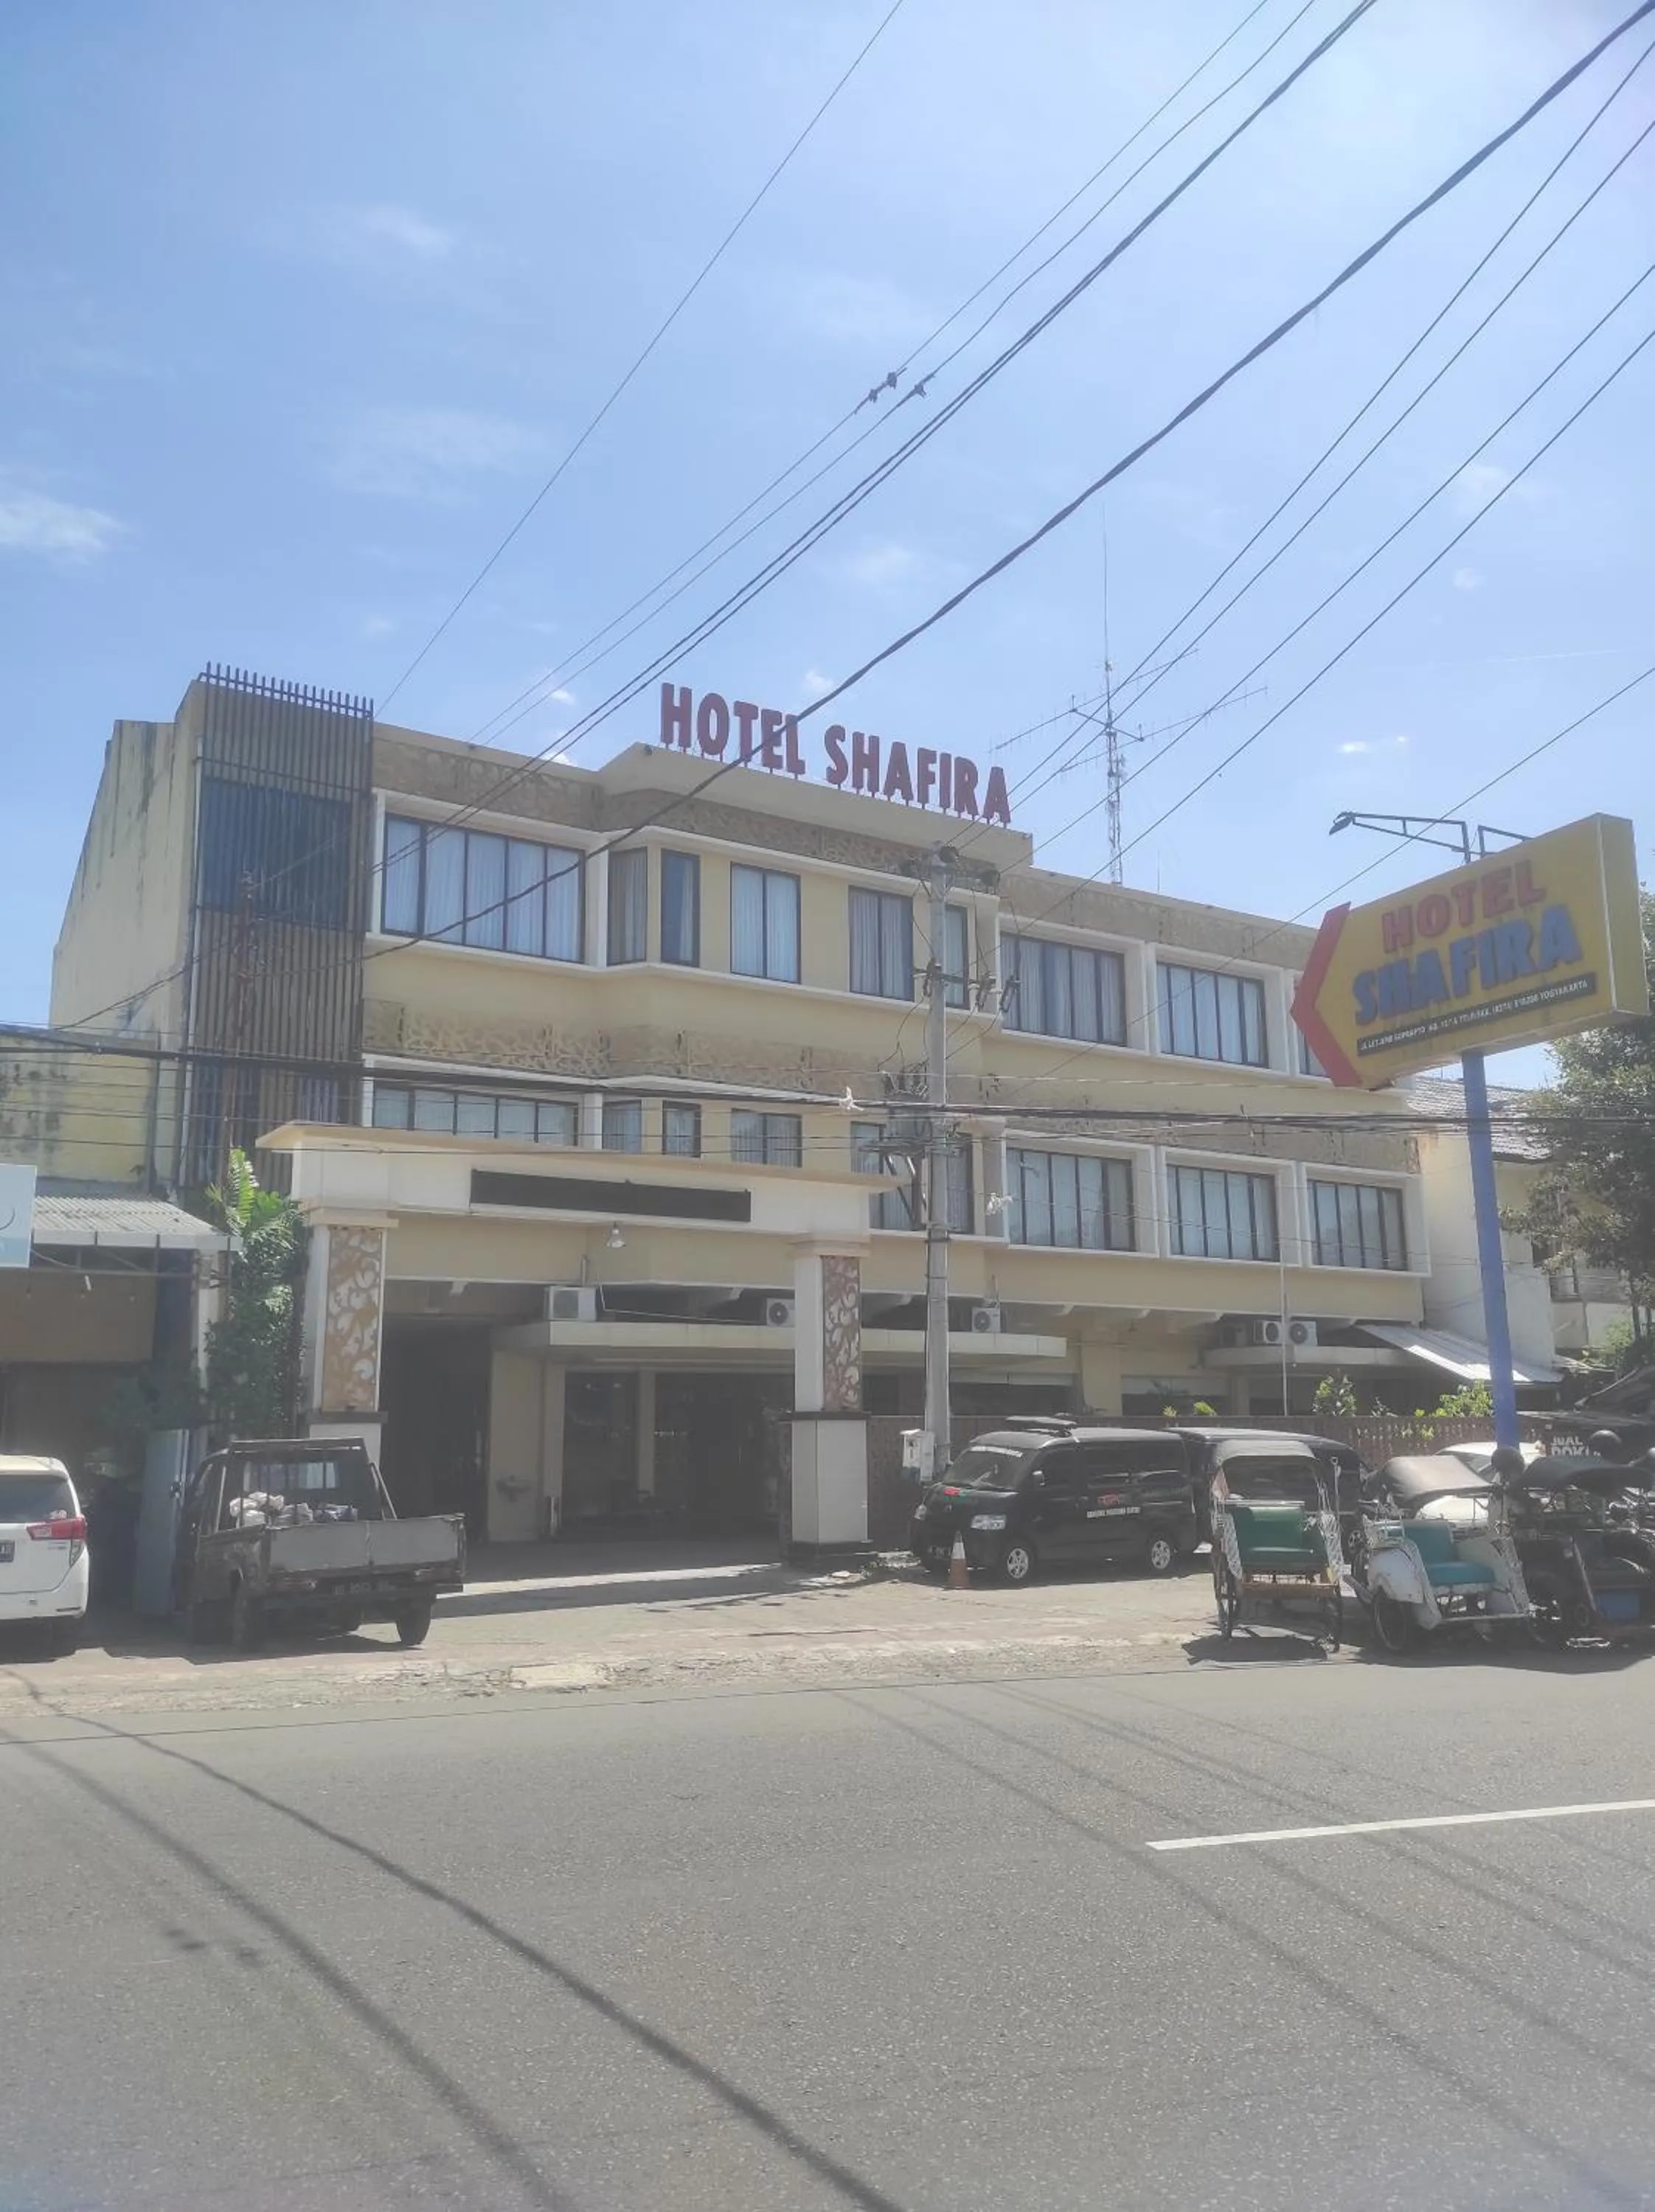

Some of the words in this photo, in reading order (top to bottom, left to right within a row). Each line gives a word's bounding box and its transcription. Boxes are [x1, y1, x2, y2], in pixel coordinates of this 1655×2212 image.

[660, 682, 806, 775] HOTEL
[824, 724, 1011, 824] SHAFIRA
[1352, 903, 1583, 1026] SHAFIRA
[1381, 859, 1547, 955] HOTEL
